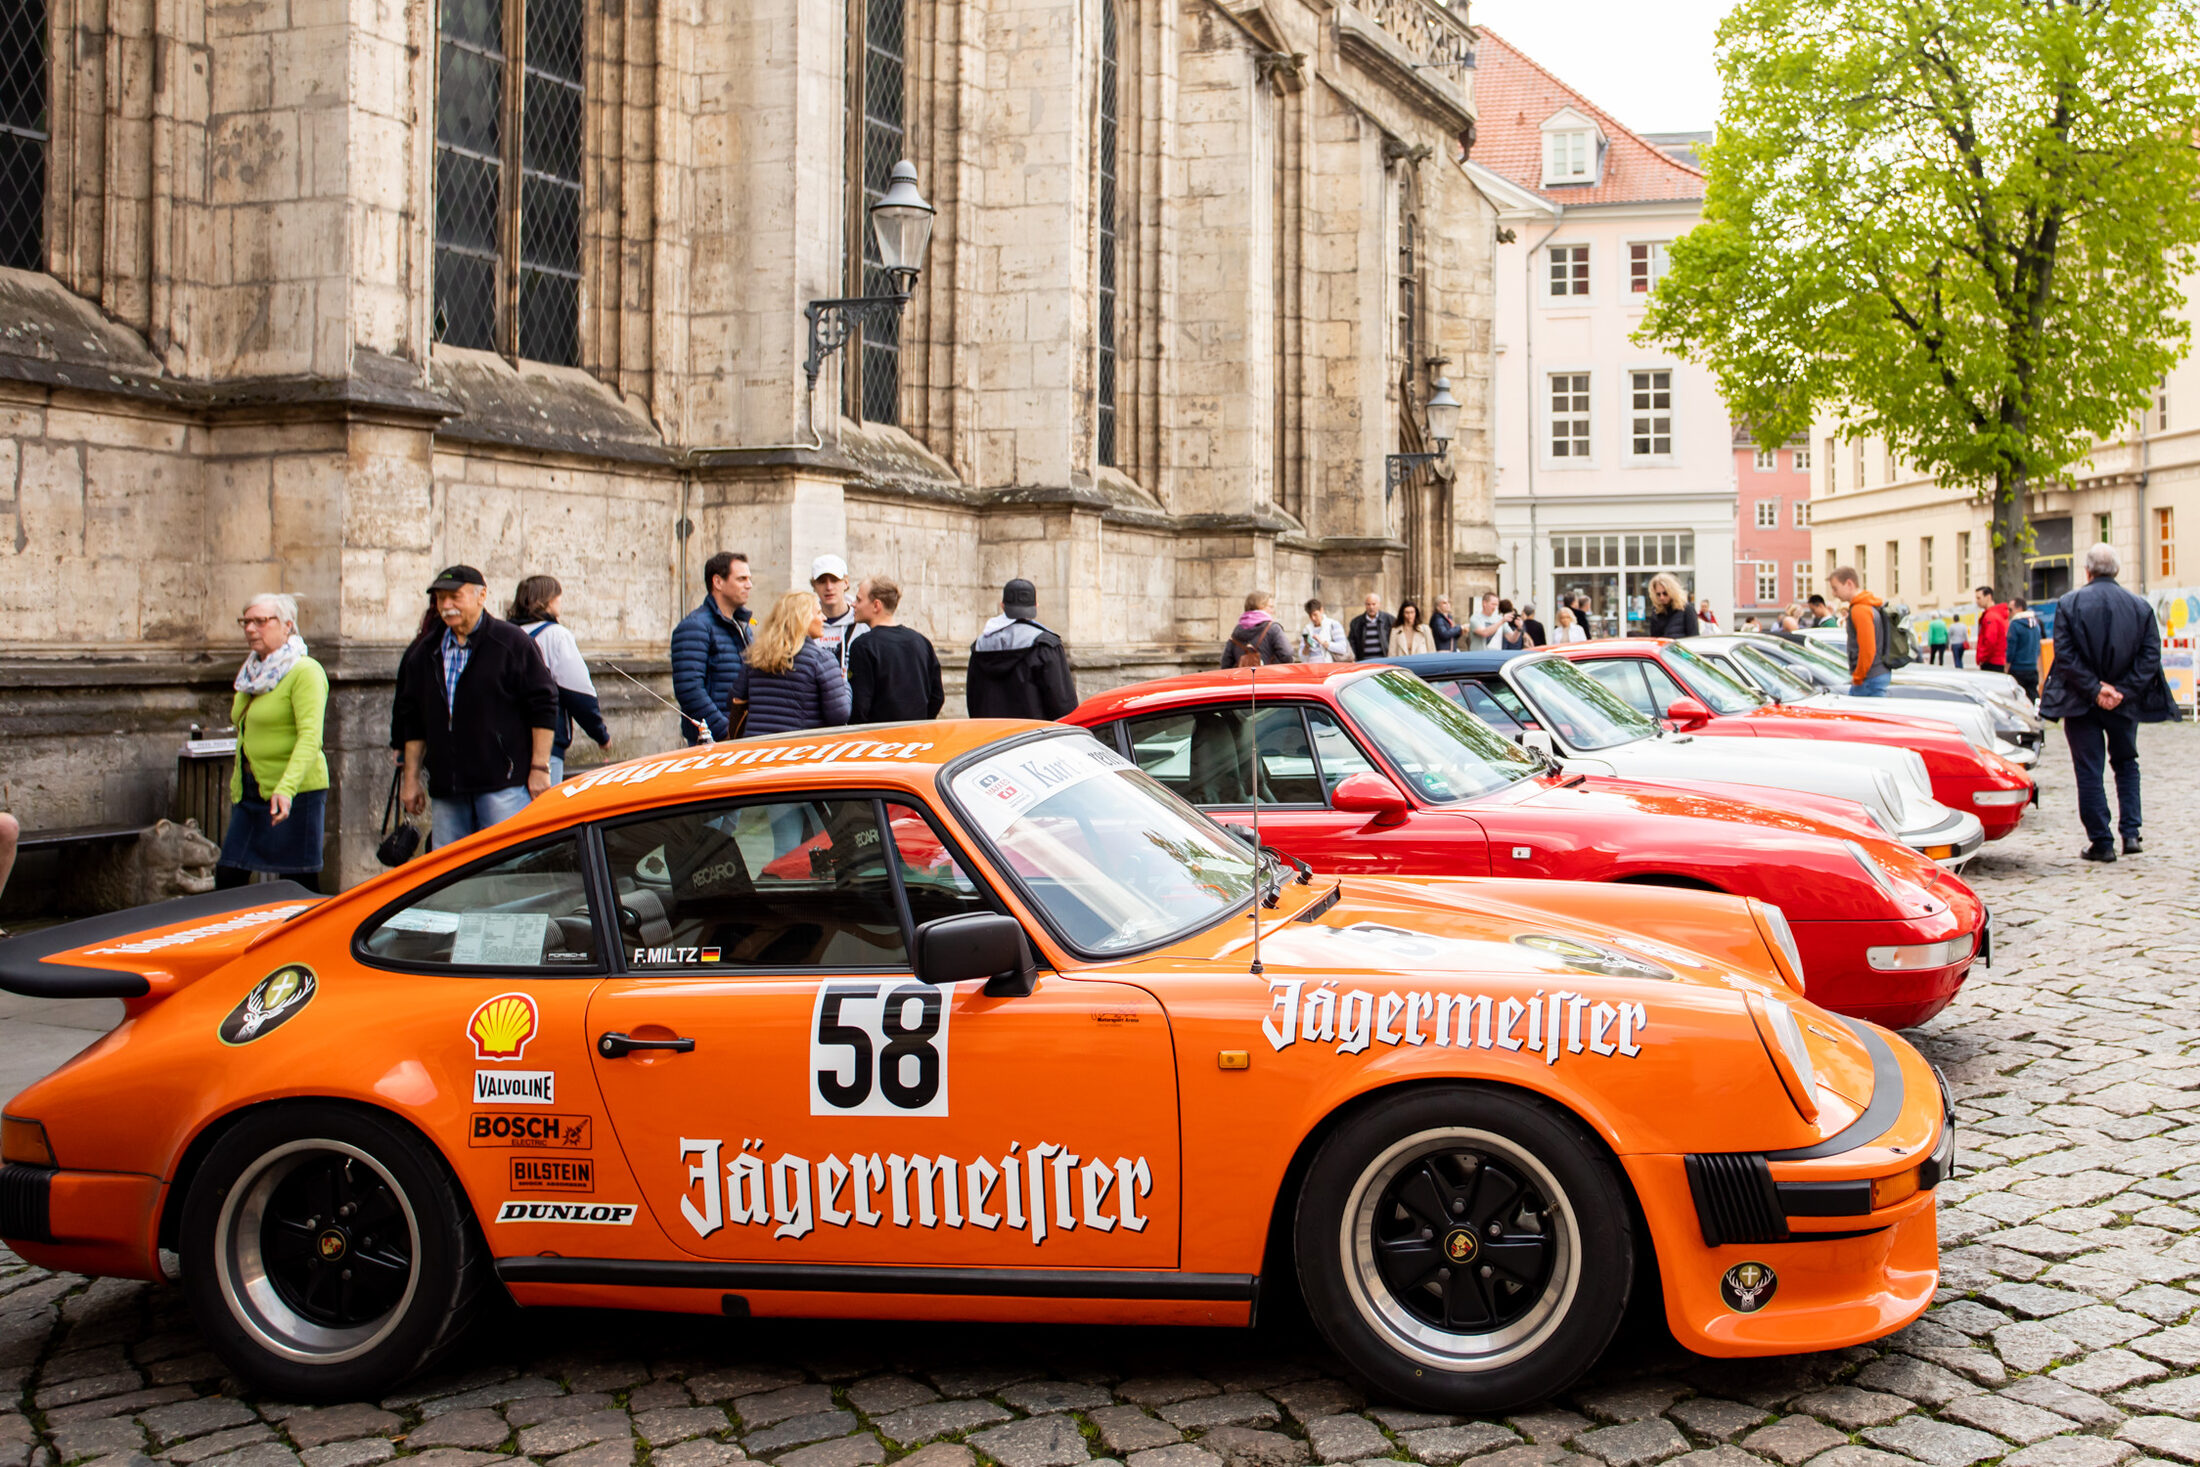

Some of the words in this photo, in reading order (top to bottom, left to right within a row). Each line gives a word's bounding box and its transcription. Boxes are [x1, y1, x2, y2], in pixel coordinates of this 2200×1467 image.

[692, 861, 737, 889] RECARO
[634, 947, 699, 964] F.MILTZ
[817, 983, 943, 1110] 58
[477, 1073, 552, 1101] VALVOLINE
[473, 1116, 559, 1139] BOSCH
[511, 1138, 547, 1147] ELECTRIC
[514, 1162, 590, 1181] BILSTEIN
[501, 1204, 633, 1222] DUNLOP
